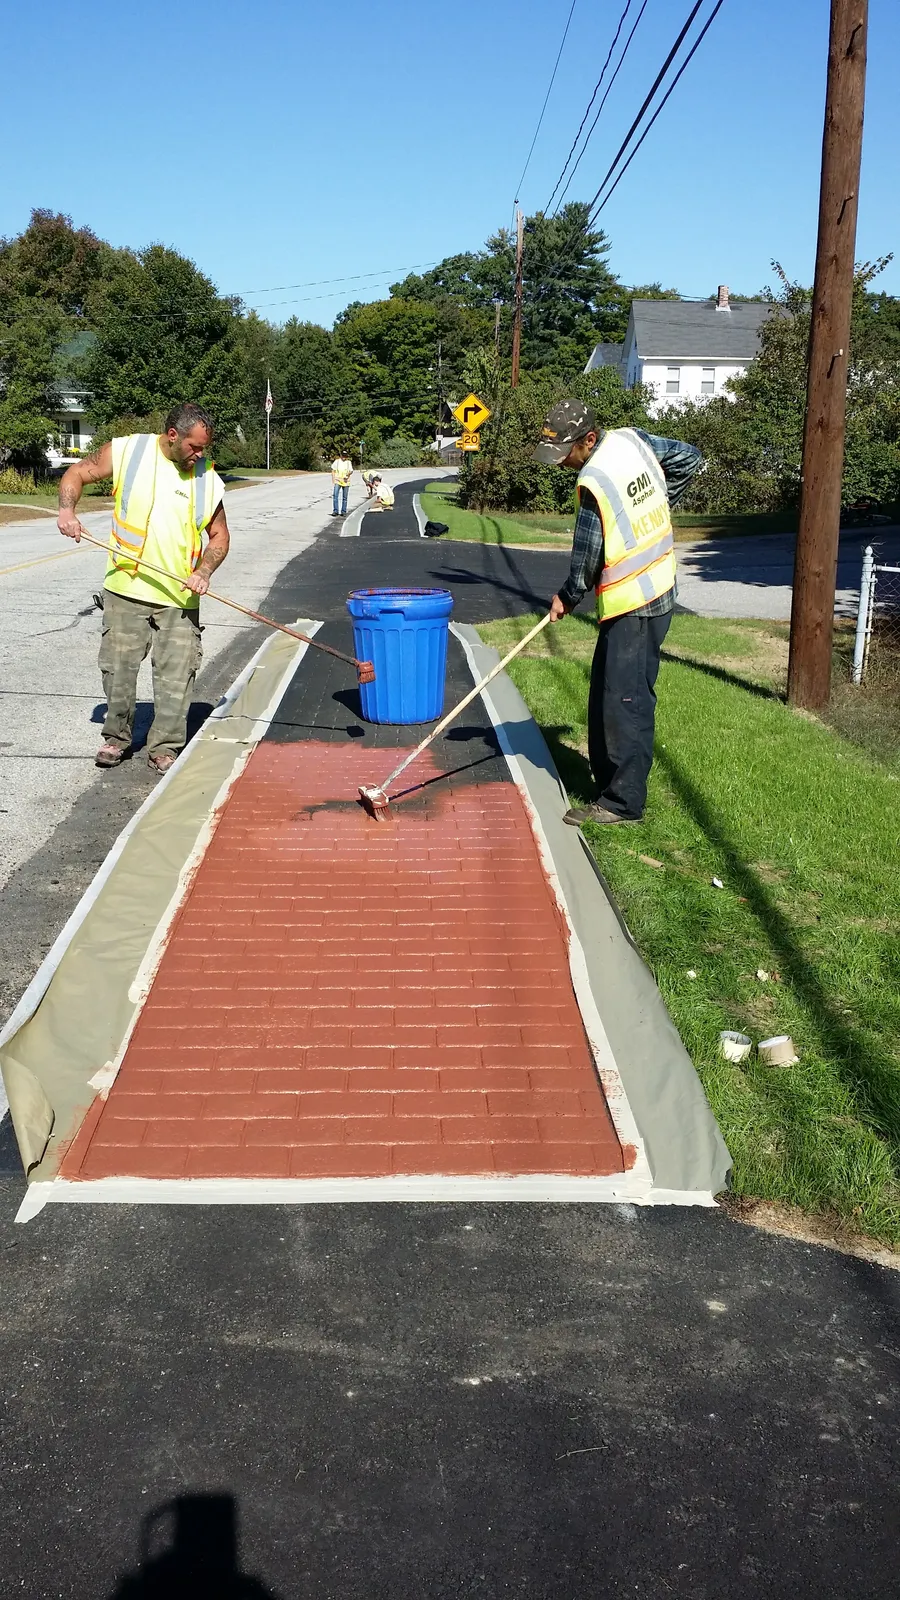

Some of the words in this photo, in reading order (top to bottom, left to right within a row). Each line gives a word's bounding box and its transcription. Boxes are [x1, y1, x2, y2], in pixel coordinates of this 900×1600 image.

[464, 435, 478, 444] 20
[626, 471, 652, 498] GMI
[632, 486, 656, 508] Asphalt
[632, 501, 670, 540] KENNY
